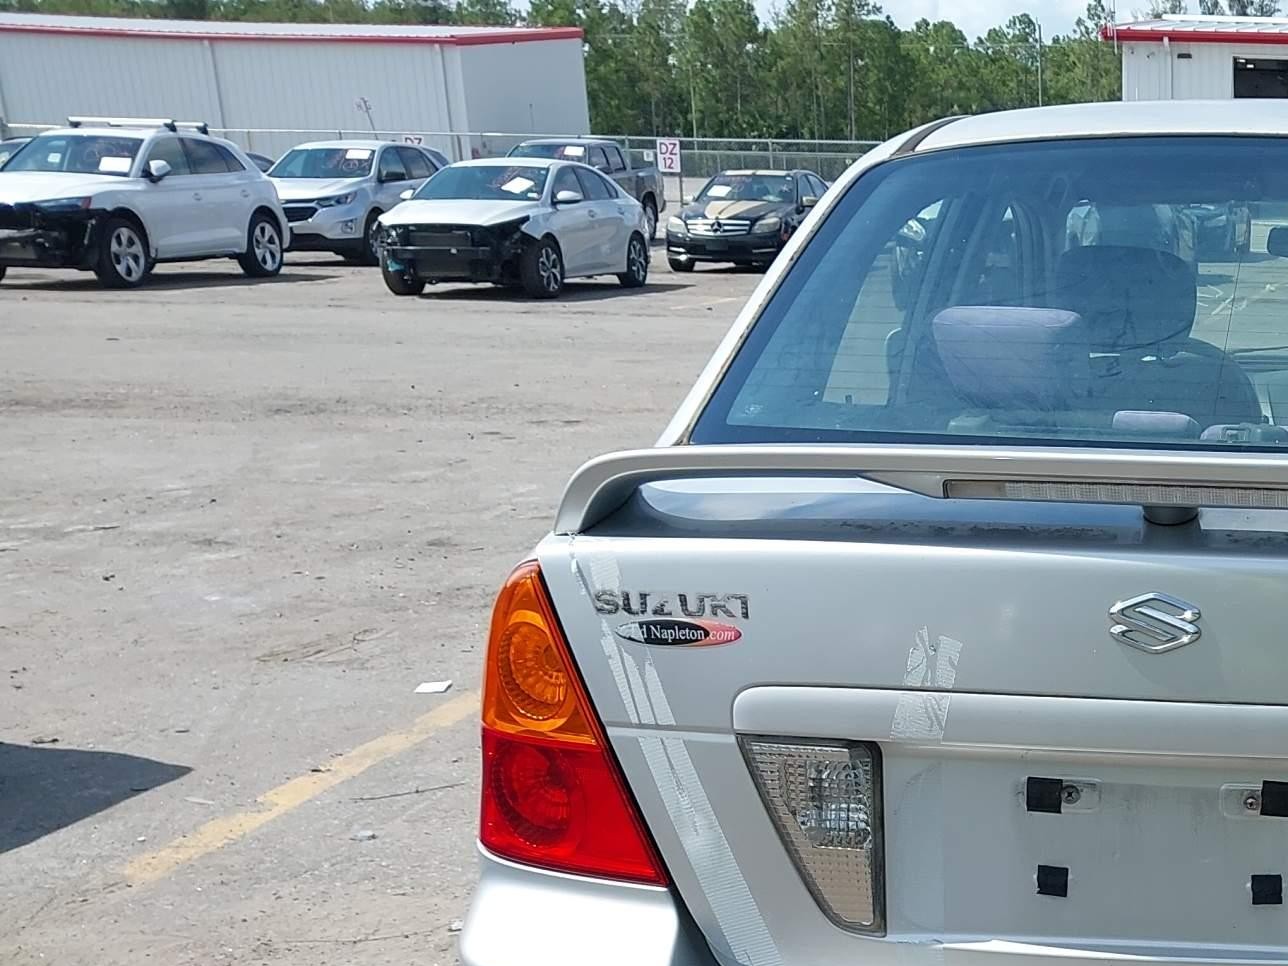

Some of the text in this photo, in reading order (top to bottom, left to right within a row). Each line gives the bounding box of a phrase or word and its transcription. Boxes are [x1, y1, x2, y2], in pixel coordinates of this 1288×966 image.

[659, 142, 678, 156] DZ
[662, 157, 675, 169] 12
[594, 590, 750, 620] SUZUKI
